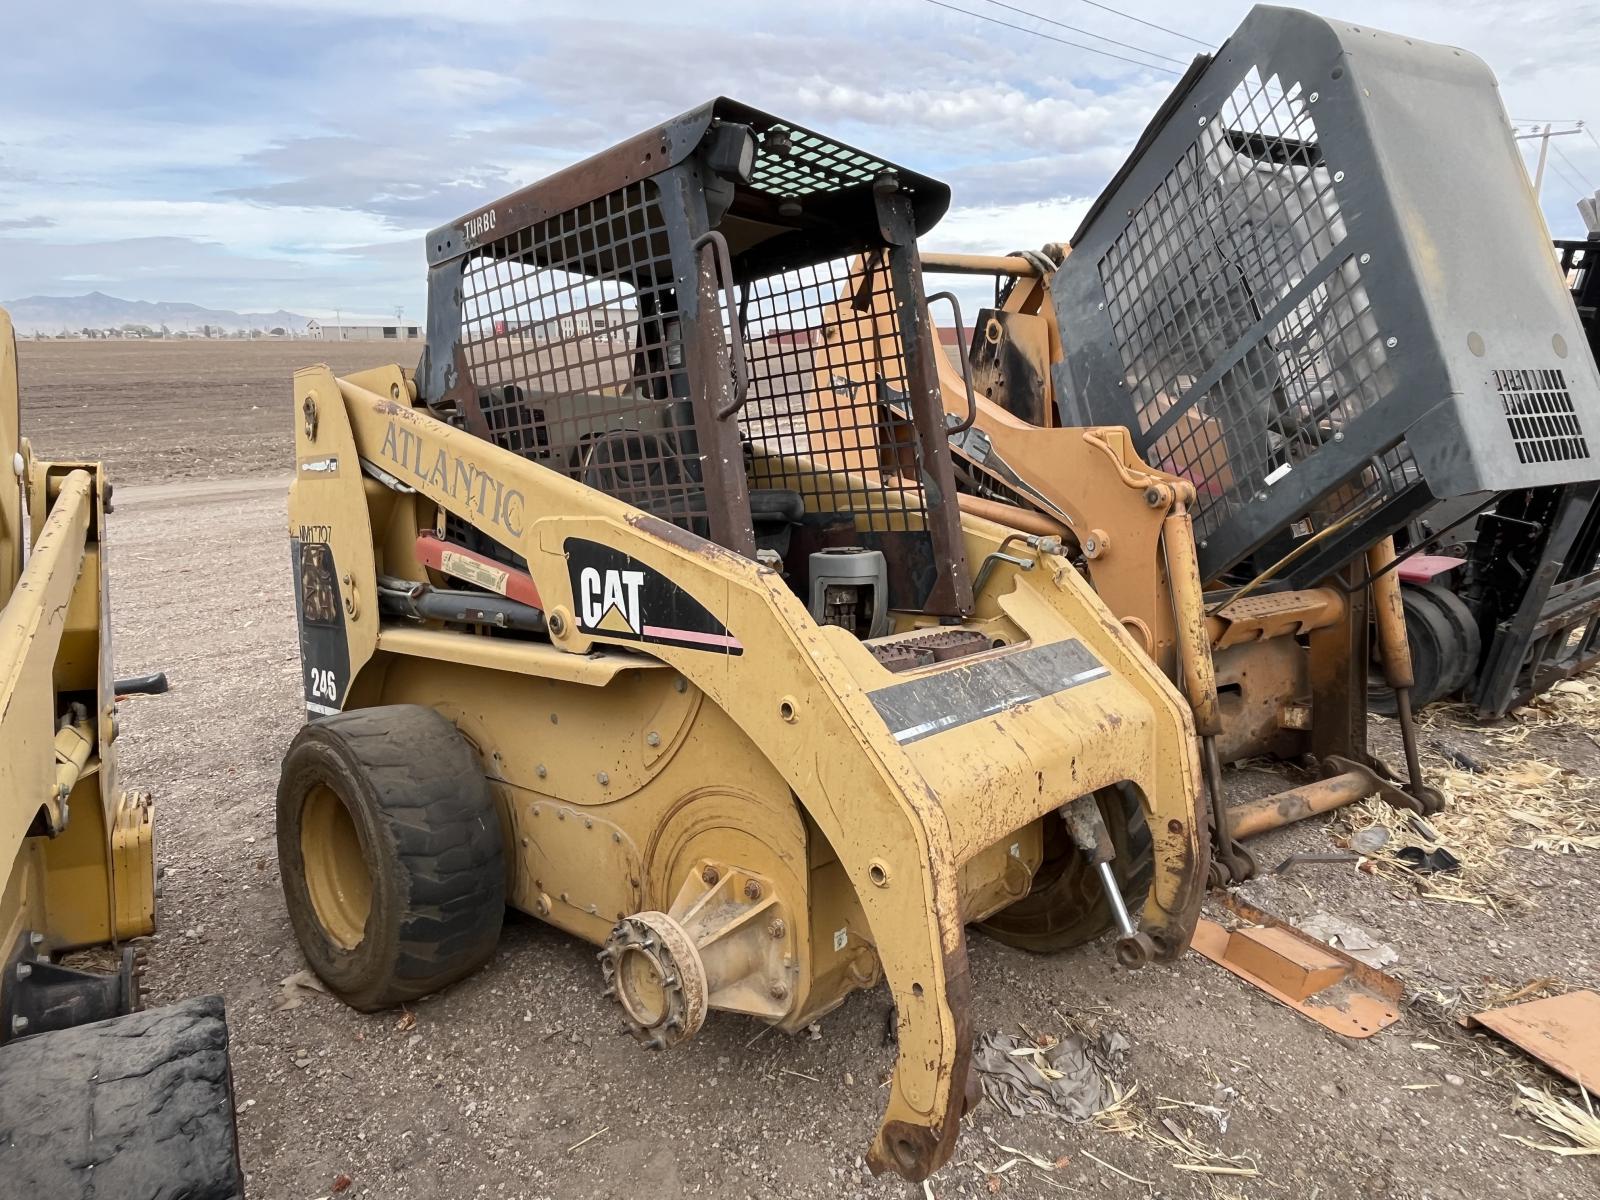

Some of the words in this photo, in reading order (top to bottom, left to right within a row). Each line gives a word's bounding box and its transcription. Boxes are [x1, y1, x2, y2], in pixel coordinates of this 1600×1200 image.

[464, 209, 496, 239] TURBO
[380, 421, 525, 538] ATLANTIC
[580, 567, 644, 634] CAT
[311, 667, 337, 701] 246
